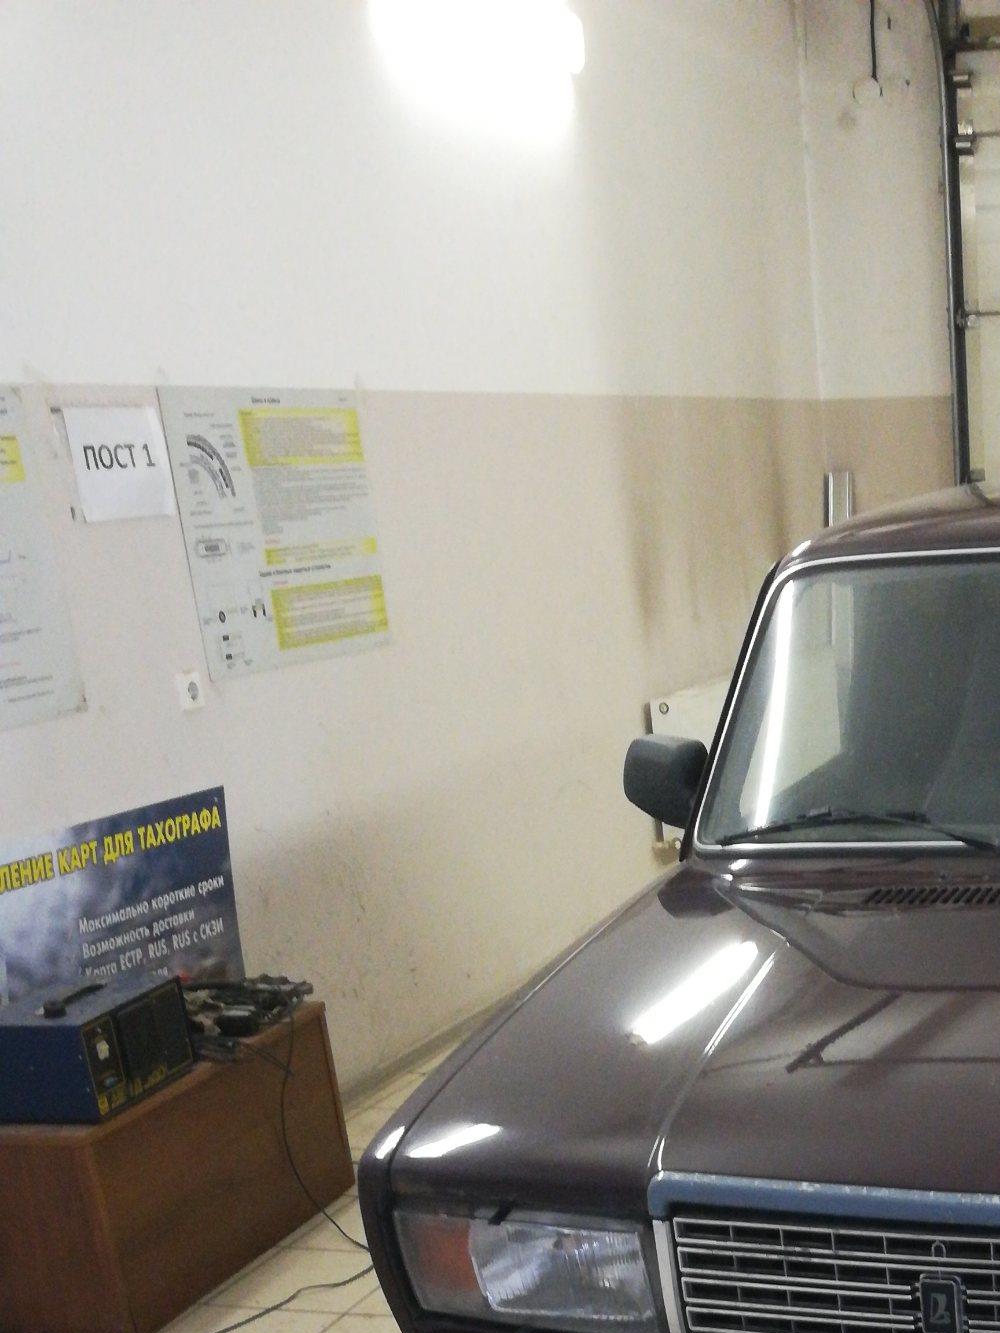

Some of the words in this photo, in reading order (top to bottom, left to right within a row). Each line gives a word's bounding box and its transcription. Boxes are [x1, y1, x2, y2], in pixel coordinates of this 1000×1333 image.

[83, 443, 136, 471] ПОСТ
[142, 443, 156, 467] 1
[57, 840, 98, 875] КАРТ
[104, 830, 135, 865] ДЛЯ
[138, 805, 222, 850] ТАХОГРАФА
[79, 901, 149, 934] Максимально
[151, 884, 196, 911] короткие
[198, 875, 225, 897] сроки
[82, 925, 150, 959] Возможность
[152, 909, 195, 936] доставки
[172, 928, 191, 951] RUS
